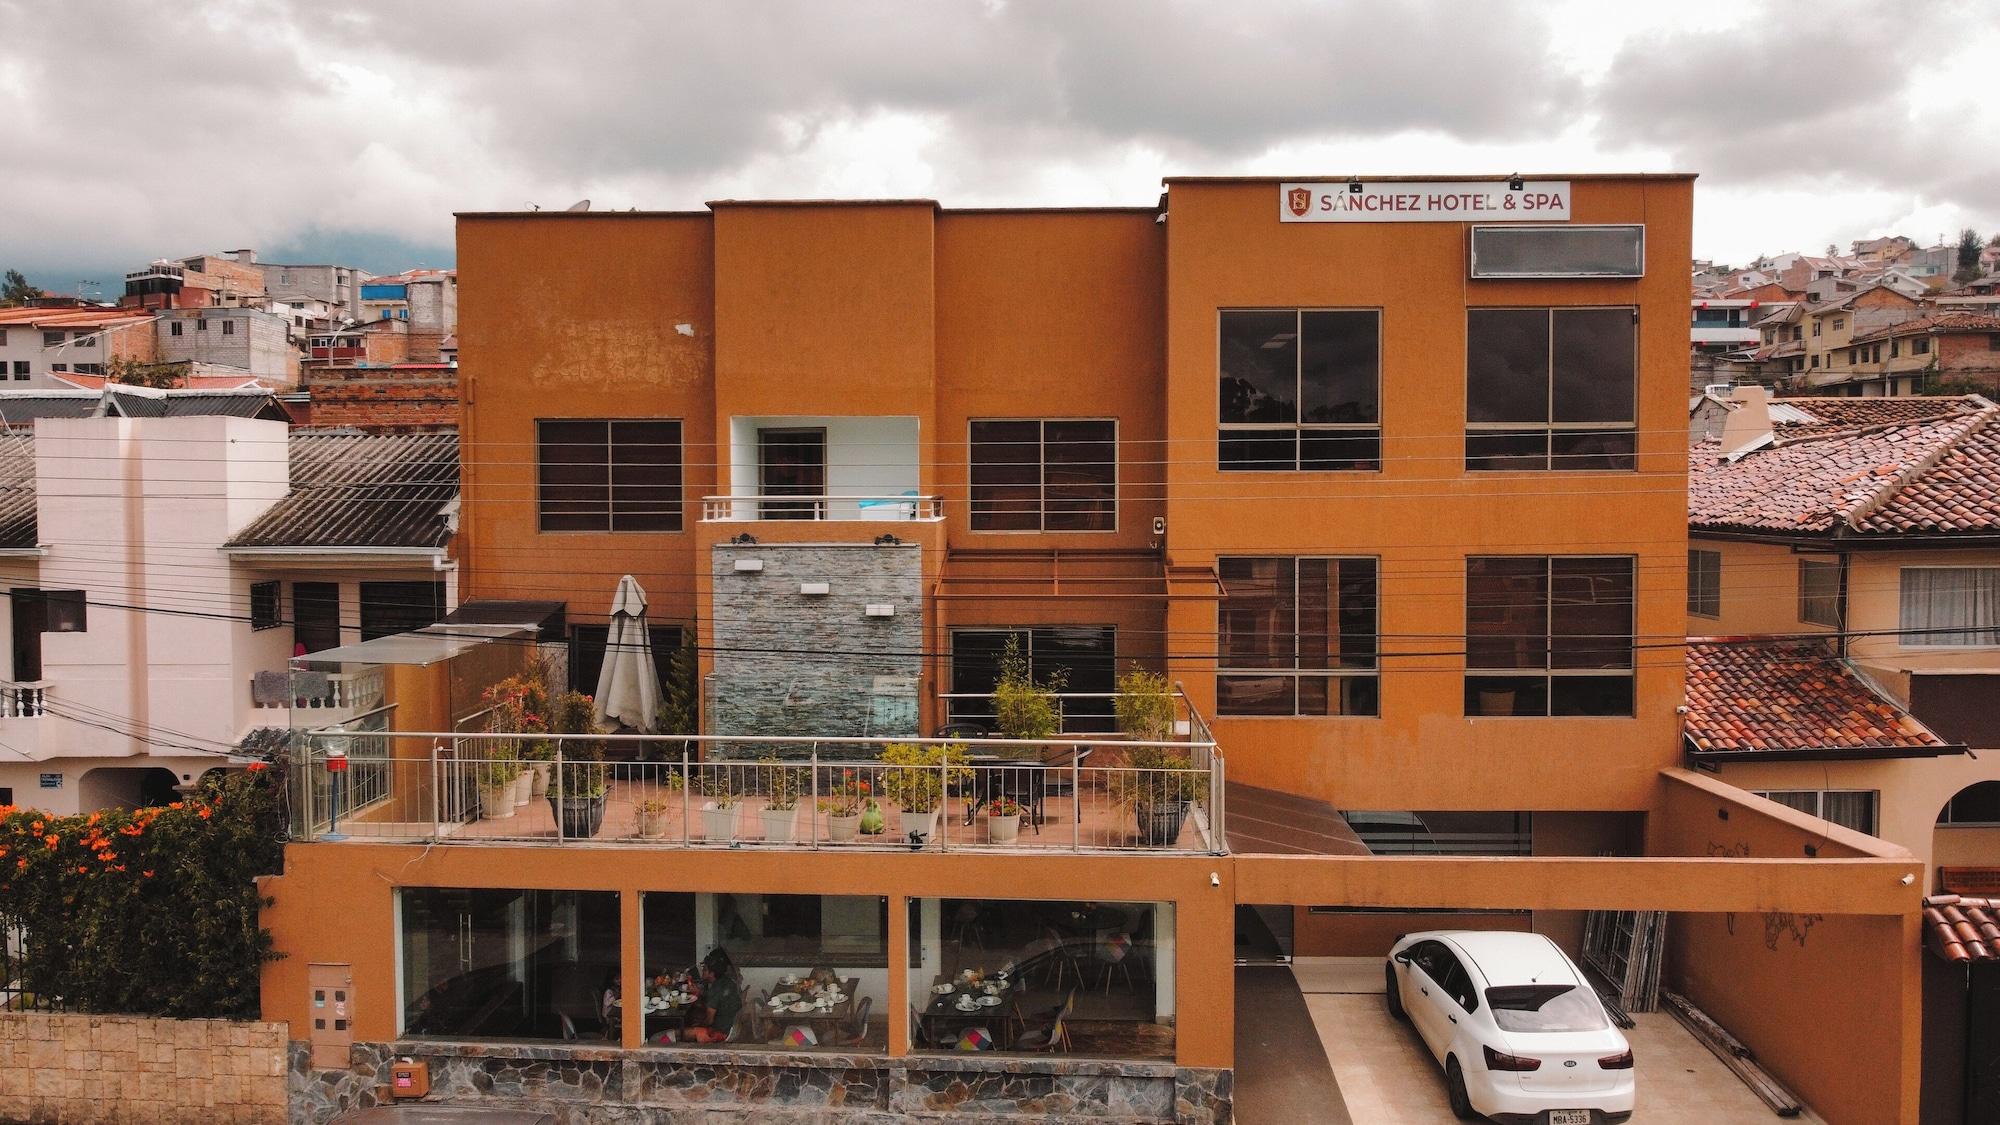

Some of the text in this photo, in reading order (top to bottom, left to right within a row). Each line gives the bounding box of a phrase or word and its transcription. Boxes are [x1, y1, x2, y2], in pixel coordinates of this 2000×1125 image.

[1321, 191, 1564, 211] SÁNCHEZ HOTEL & SPA
